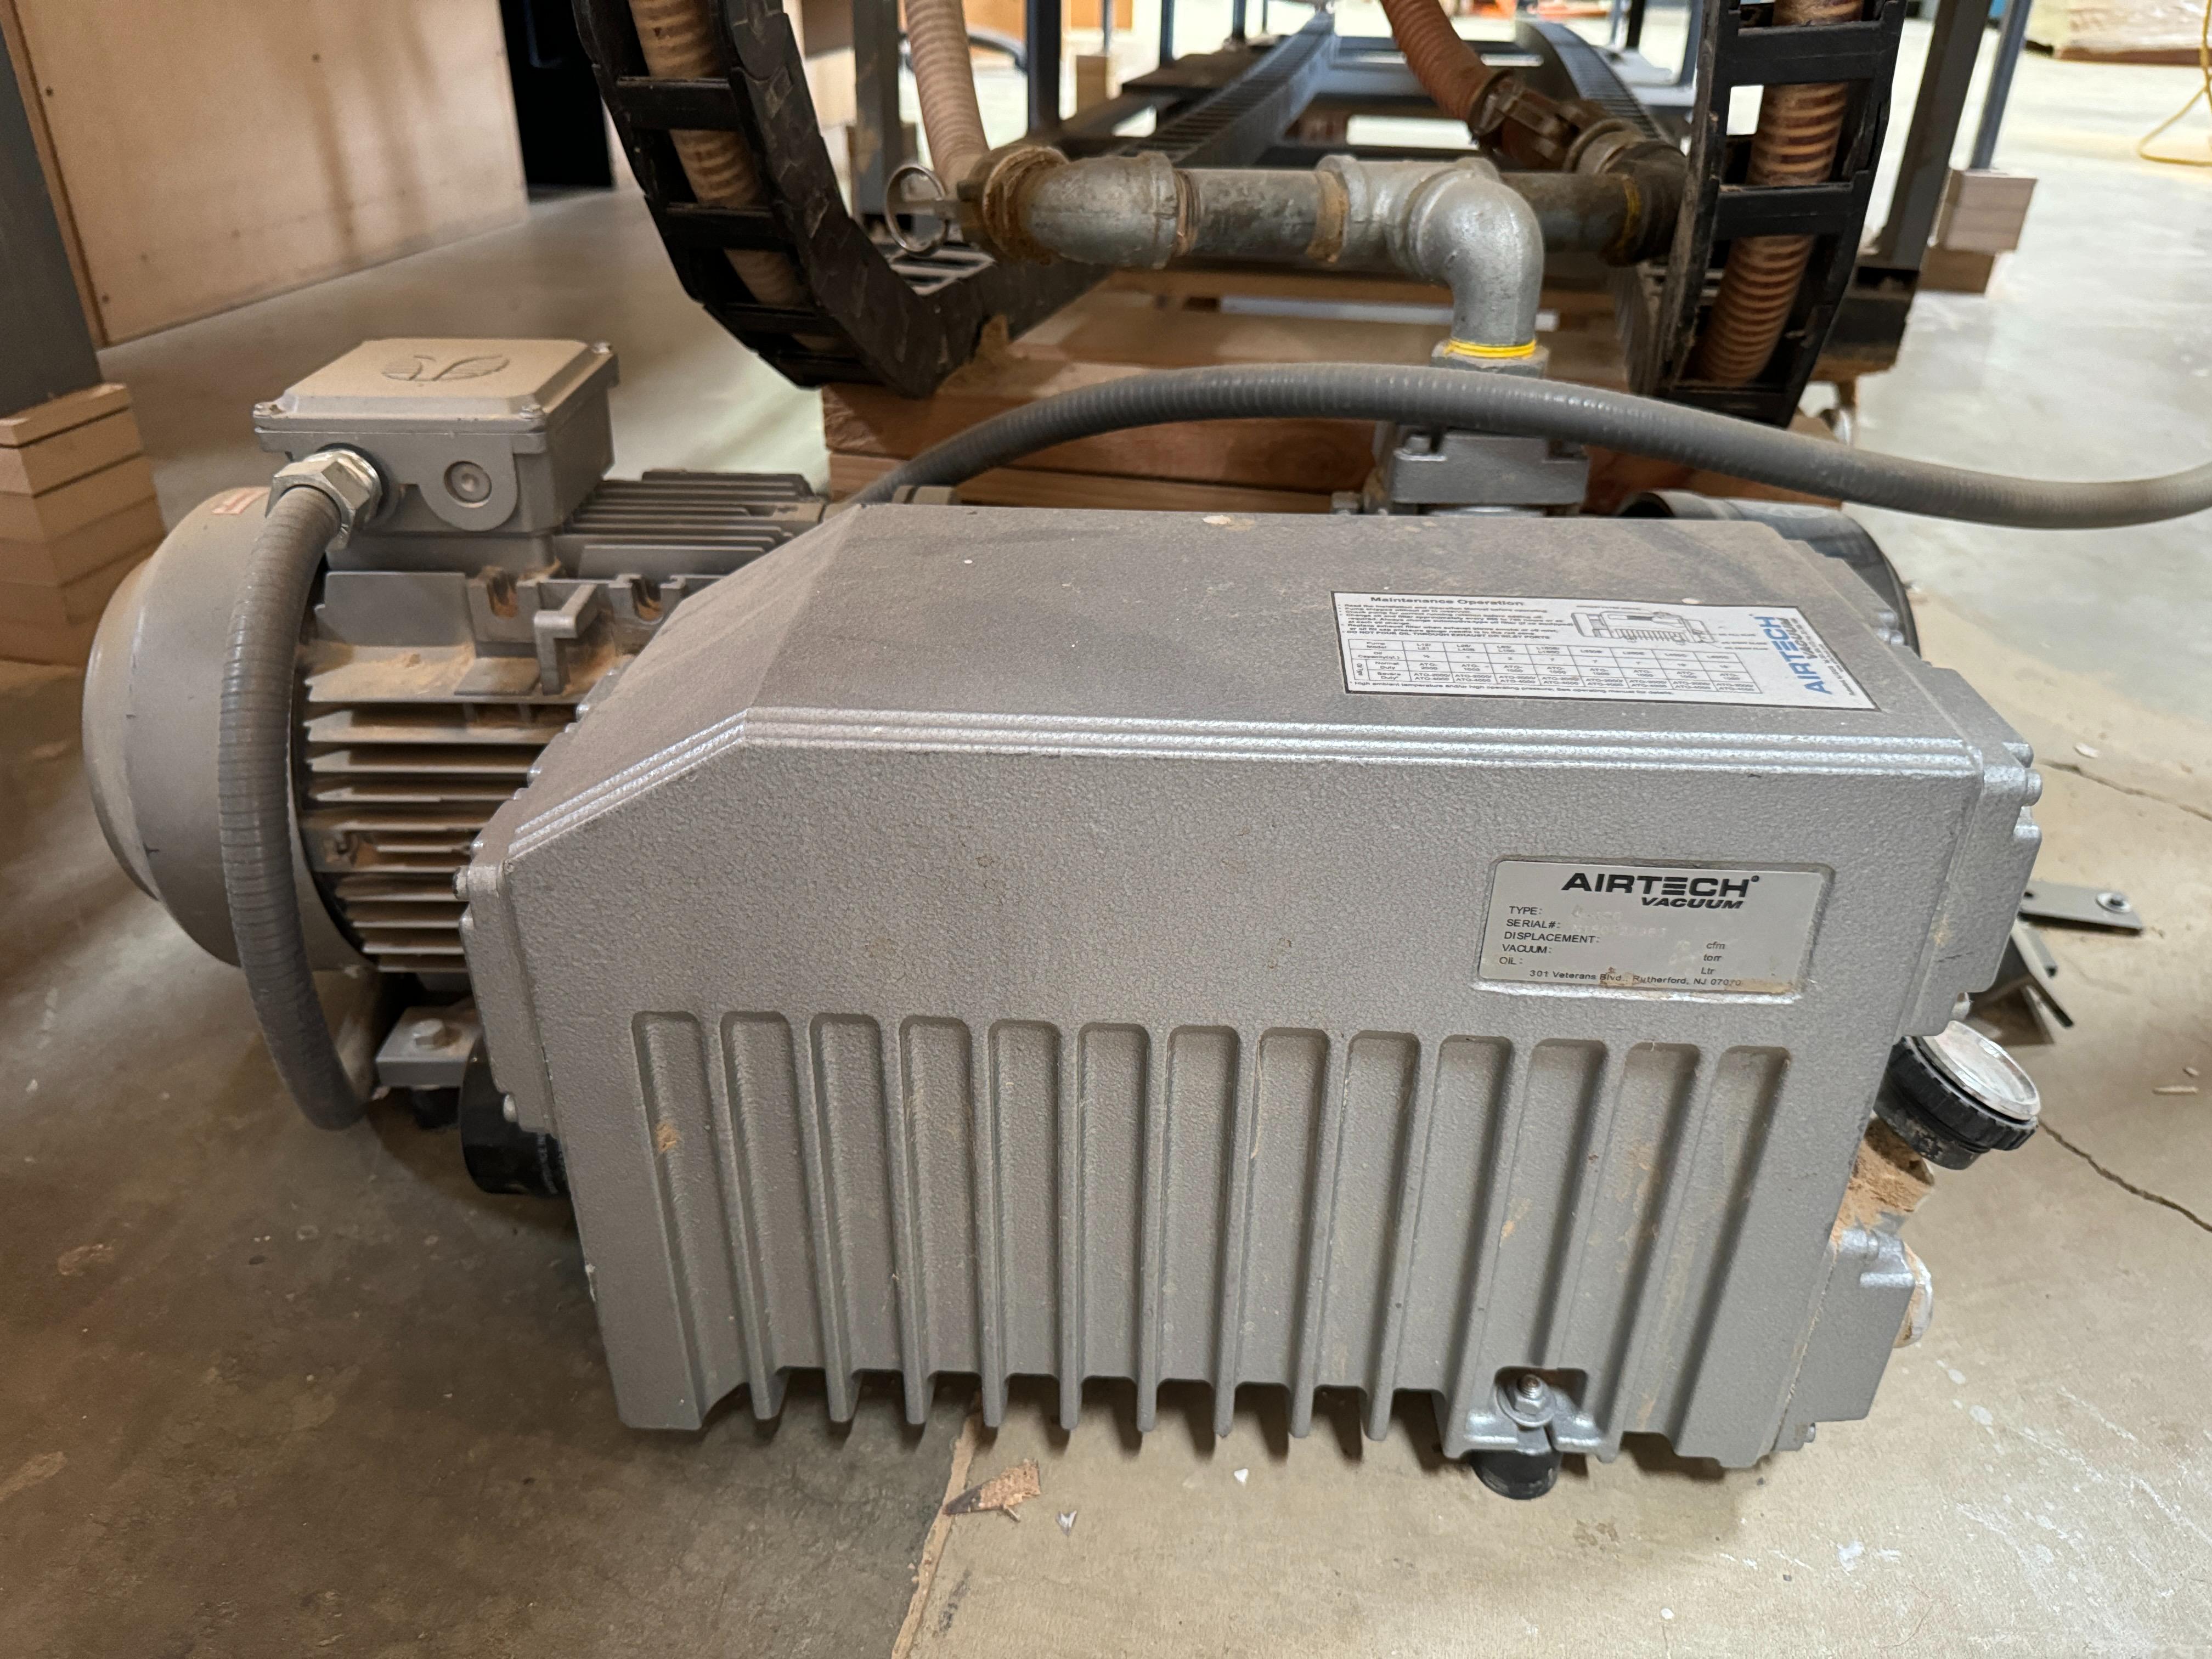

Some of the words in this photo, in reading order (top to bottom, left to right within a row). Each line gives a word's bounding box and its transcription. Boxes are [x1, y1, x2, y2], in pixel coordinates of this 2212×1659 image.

[1754, 616, 1832, 695] AIRTECH
[1641, 897, 1743, 909] VACUUM
[1509, 906, 1543, 915] TYPE:
[1506, 919, 1561, 928] SERIAL#:
[1504, 932, 1600, 944] DISPLACEMENT:
[1502, 944, 1553, 954] VACUUM:
[1706, 941, 1725, 950] cfm
[1553, 971, 1596, 980] Veterans
[1701, 967, 1715, 975] Ltr
